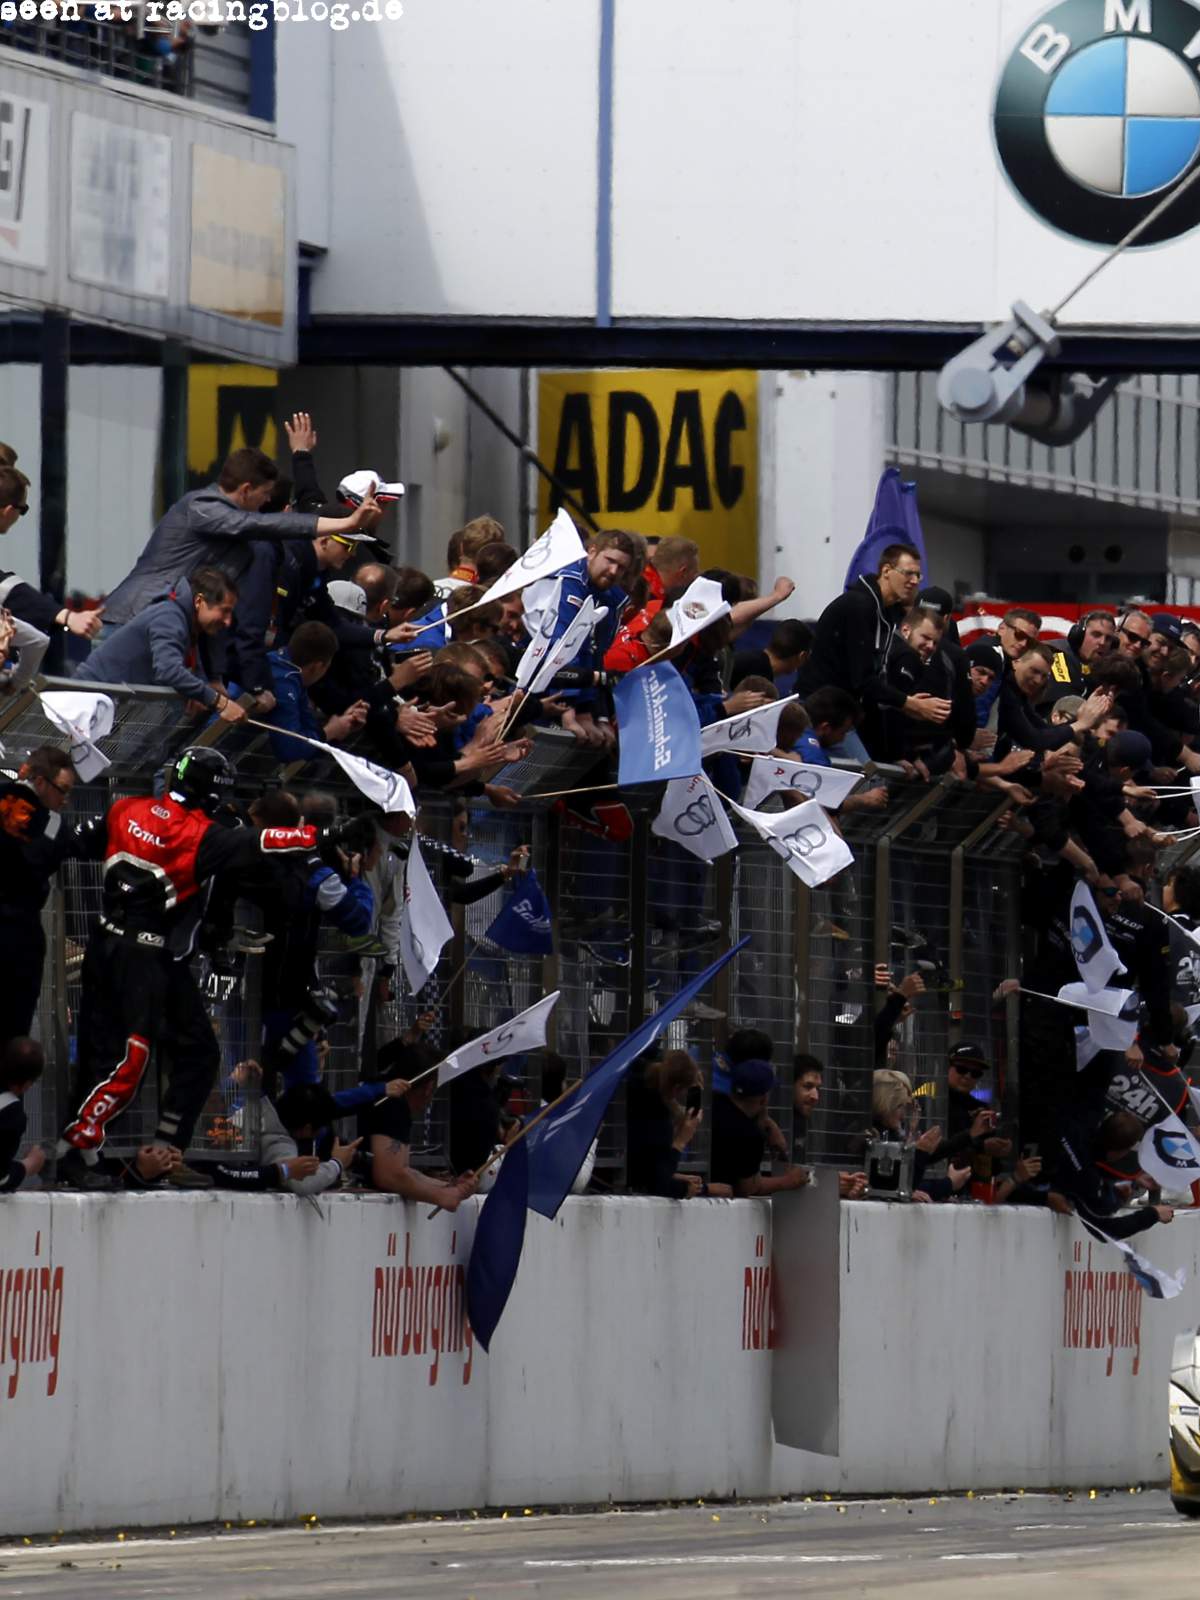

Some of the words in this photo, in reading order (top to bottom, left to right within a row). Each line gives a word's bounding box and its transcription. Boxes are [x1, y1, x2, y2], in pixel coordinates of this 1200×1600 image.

[549, 388, 747, 513] ADAC
[127, 819, 166, 848] TOTAL
[269, 829, 312, 840] TOTAL
[1107, 1074, 1160, 1120] 24h
